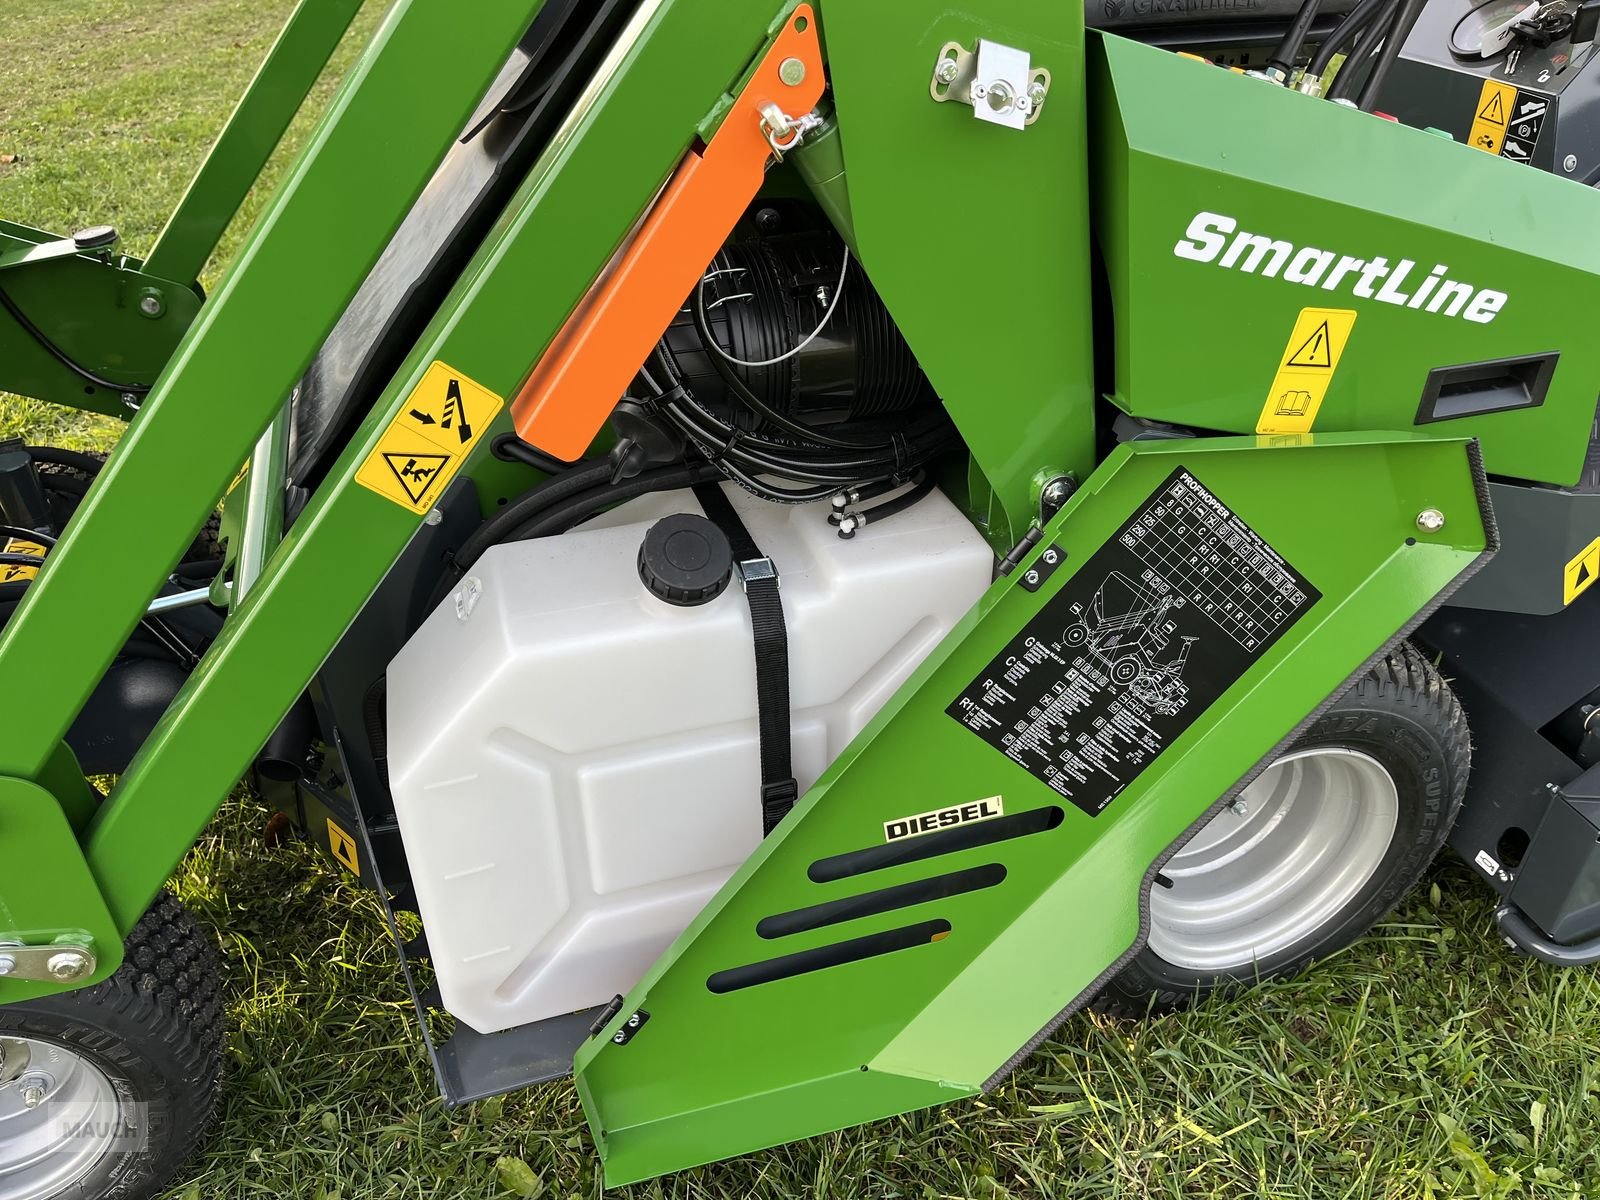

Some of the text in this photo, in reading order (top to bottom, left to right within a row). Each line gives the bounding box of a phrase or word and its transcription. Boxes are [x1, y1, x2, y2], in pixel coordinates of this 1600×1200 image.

[1174, 212, 1508, 324] SmartLine
[1179, 472, 1229, 519] PROFIHOPPER
[1142, 514, 1209, 575] 125 R R
[1154, 506, 1282, 619] 50 G R1 R1 R1 C
[1166, 499, 1174, 507] 8
[1174, 506, 1183, 515] G
[1197, 527, 1206, 535] C
[1208, 536, 1216, 544] C
[1230, 556, 1239, 564] C
[1241, 566, 1249, 574] C
[1122, 533, 1254, 647] 500 R R R
[1131, 523, 1253, 629] 250 R R R
[1005, 656, 1016, 666] C
[1024, 636, 1035, 647] G
[958, 696, 974, 710] R1
[982, 678, 993, 690] R
[886, 802, 998, 840] DIESEL
[1416, 767, 1441, 846] SUPER
